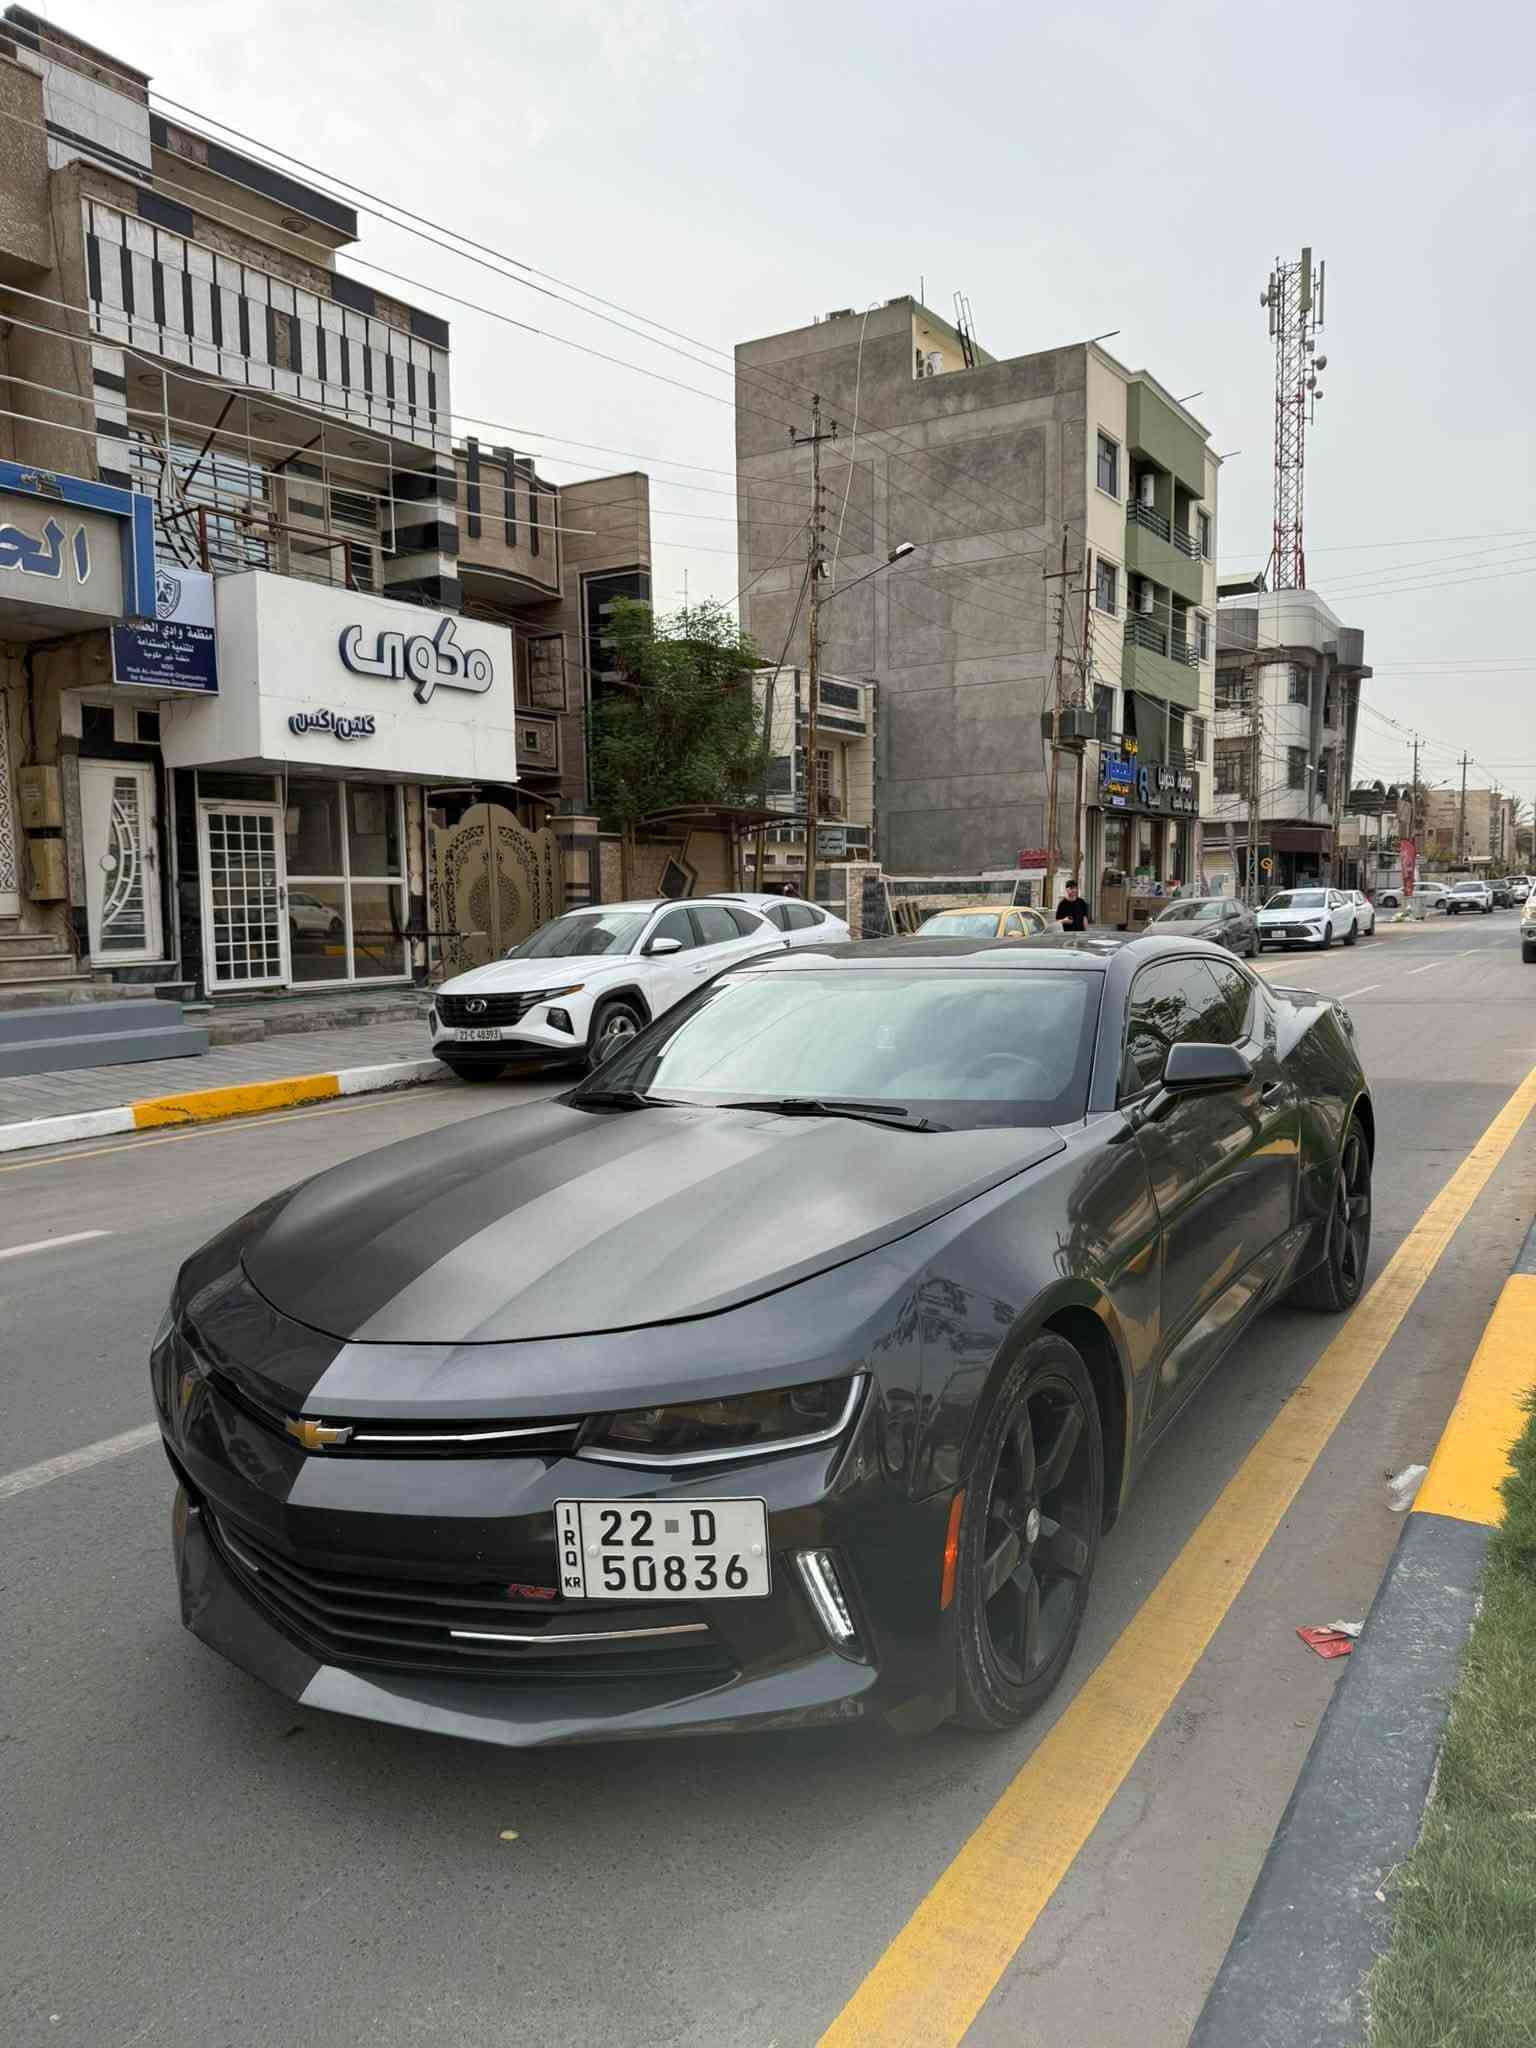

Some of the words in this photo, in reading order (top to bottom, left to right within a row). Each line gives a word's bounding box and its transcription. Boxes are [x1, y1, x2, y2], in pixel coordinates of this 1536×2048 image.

[600, 1509, 654, 1547] 22
[690, 1509, 717, 1546] D
[564, 1576, 581, 1589] KR
[602, 1554, 749, 1592] 50836
